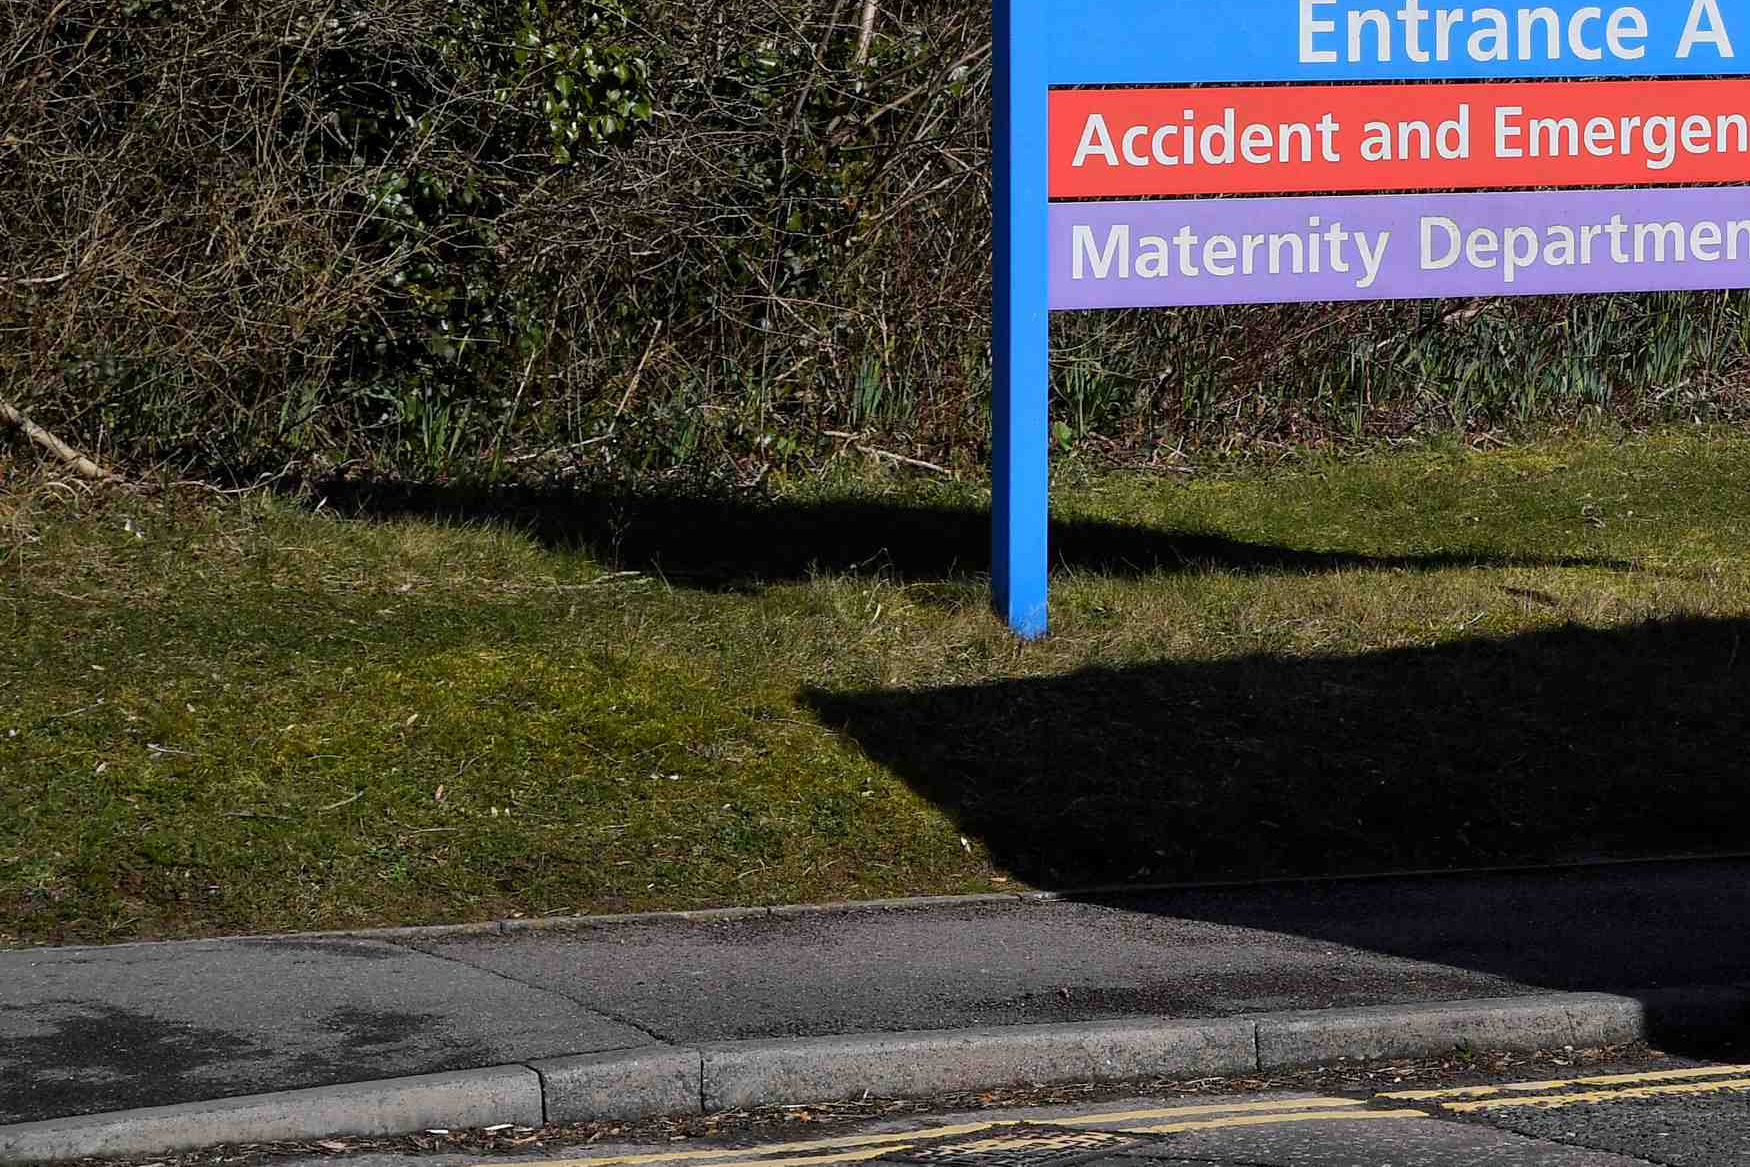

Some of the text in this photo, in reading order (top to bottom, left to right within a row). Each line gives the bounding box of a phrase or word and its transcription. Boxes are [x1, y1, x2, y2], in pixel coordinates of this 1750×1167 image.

[1072, 108, 1340, 167] Accident
[1361, 104, 1469, 161] and
[1071, 217, 1390, 288] Maternity
